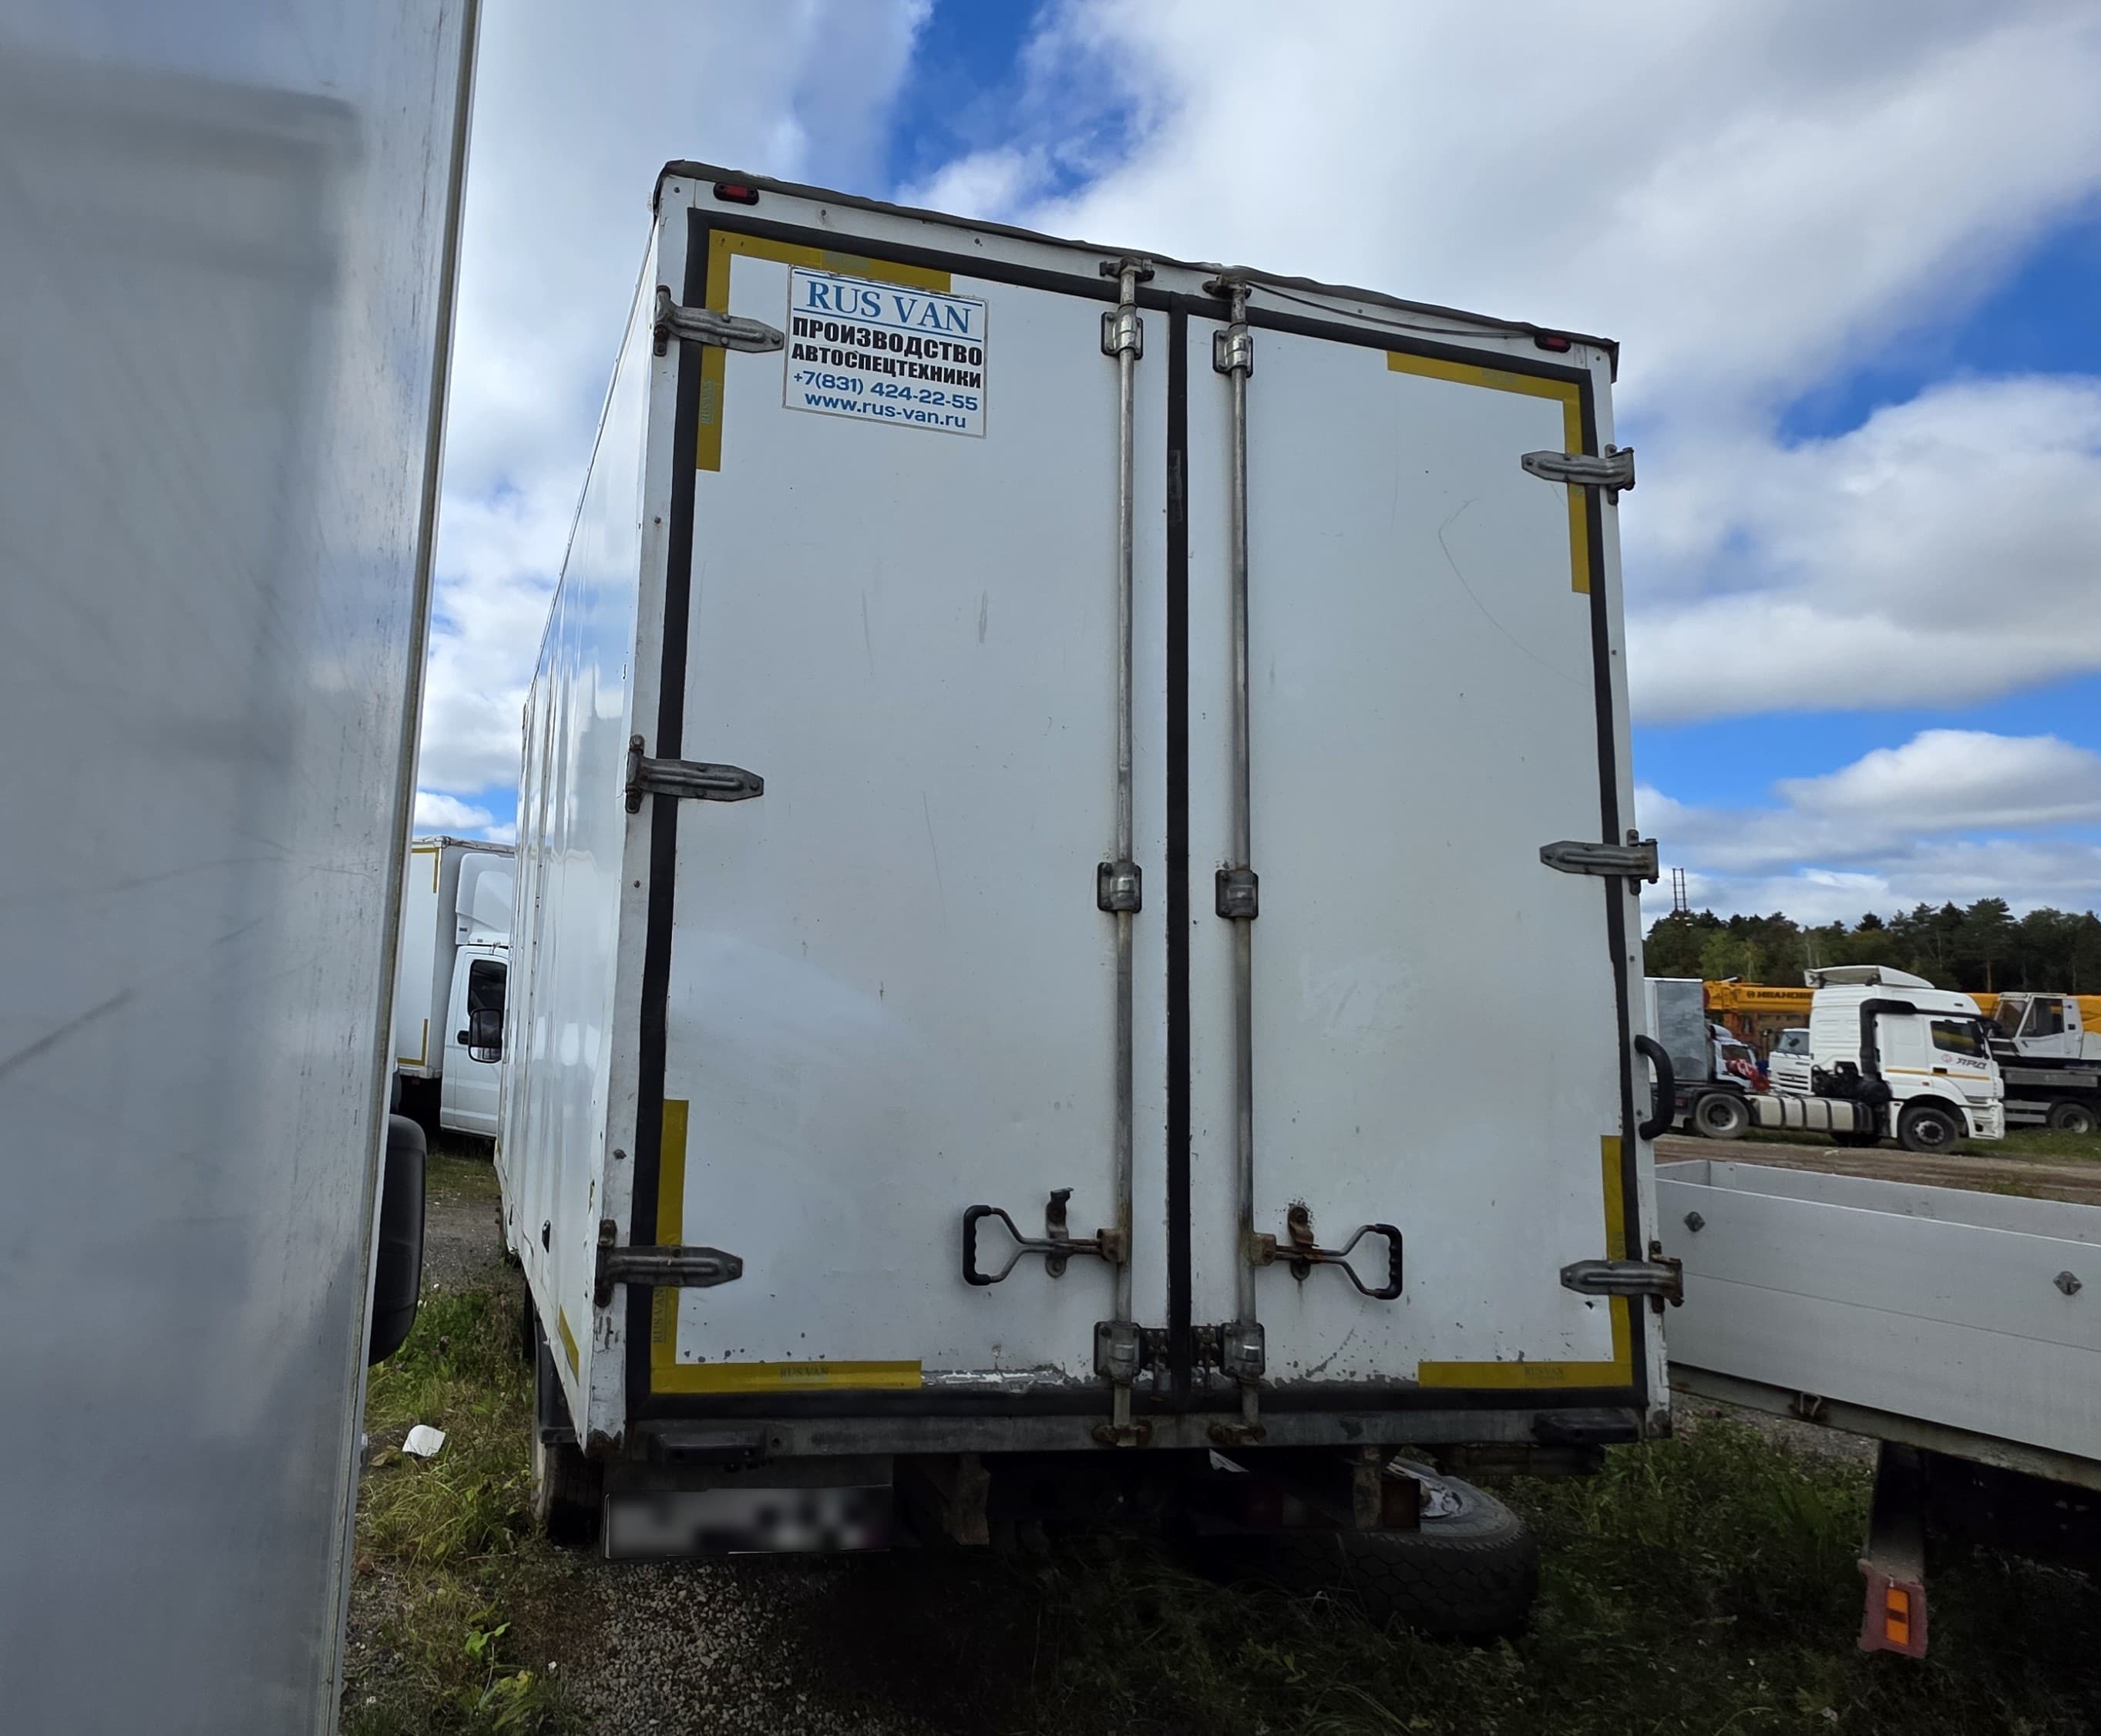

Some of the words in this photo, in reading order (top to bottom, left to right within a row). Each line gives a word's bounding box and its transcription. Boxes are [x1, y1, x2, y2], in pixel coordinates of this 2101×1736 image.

[805, 280, 881, 318] RUS
[892, 295, 972, 334] VAN
[792, 317, 983, 366] ПРОИЗВОДСТВО
[792, 343, 981, 389] АВТОСПЕЦТЕХНИКИ
[793, 370, 864, 395] +7(831)
[870, 382, 978, 411] 424-22-55
[805, 392, 966, 428] www.rus-van.ru
